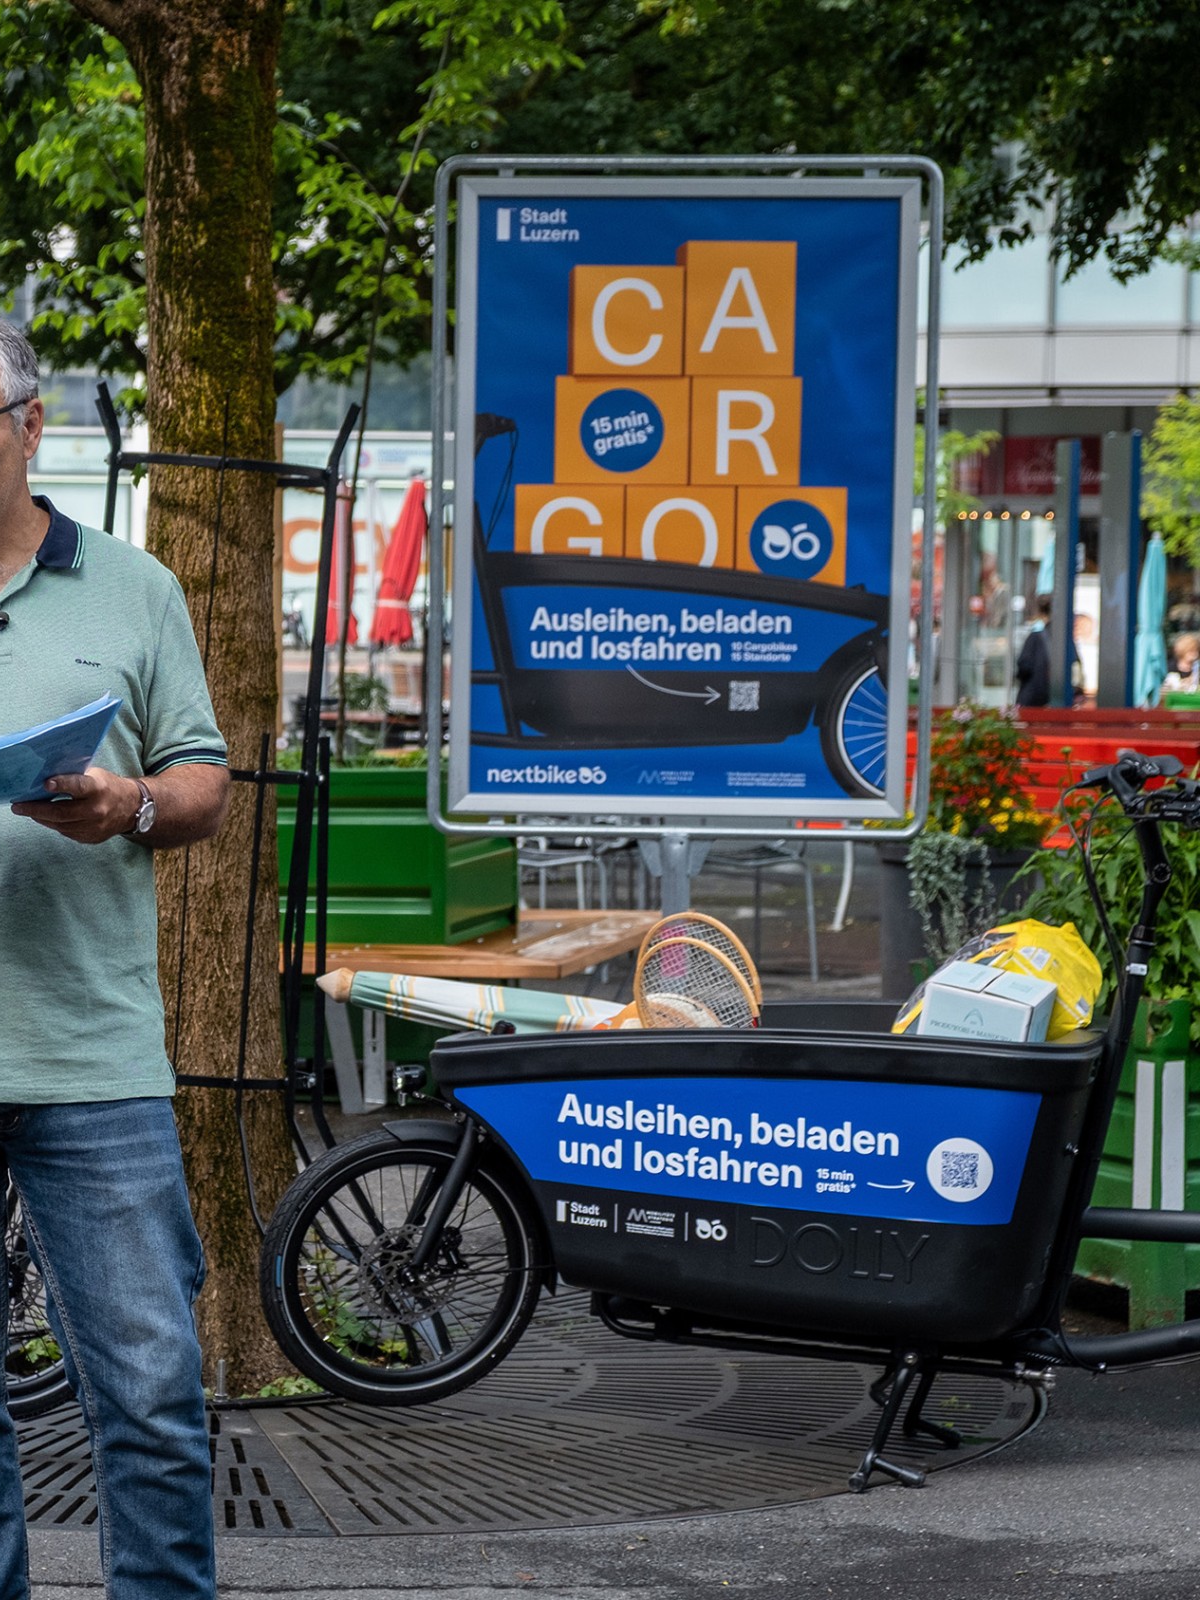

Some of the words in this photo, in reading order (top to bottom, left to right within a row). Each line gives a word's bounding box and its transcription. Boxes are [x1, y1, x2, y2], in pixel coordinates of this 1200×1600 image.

[520, 207, 568, 224] Stadt
[520, 225, 580, 242] Luzern
[590, 416, 613, 435] 15
[613, 410, 649, 431] min
[715, 390, 779, 476] R
[529, 606, 677, 637] Ausleihen,
[681, 608, 792, 635] beladen
[530, 635, 583, 660] und
[591, 635, 722, 661] losfahren
[743, 641, 798, 653] Cargobikes
[75, 658, 101, 668] GANT
[743, 652, 792, 662] Standorte
[487, 765, 577, 784] nextbike
[557, 1093, 743, 1148] Ausleihen,
[750, 1113, 900, 1157] beladen
[558, 1138, 623, 1170] und
[633, 1141, 802, 1188] losfahren
[816, 1168, 830, 1179] 15
[831, 1170, 854, 1181] min
[570, 1202, 600, 1216] Stadt
[570, 1213, 607, 1228] Luzern
[750, 1215, 930, 1285] DOLLY
